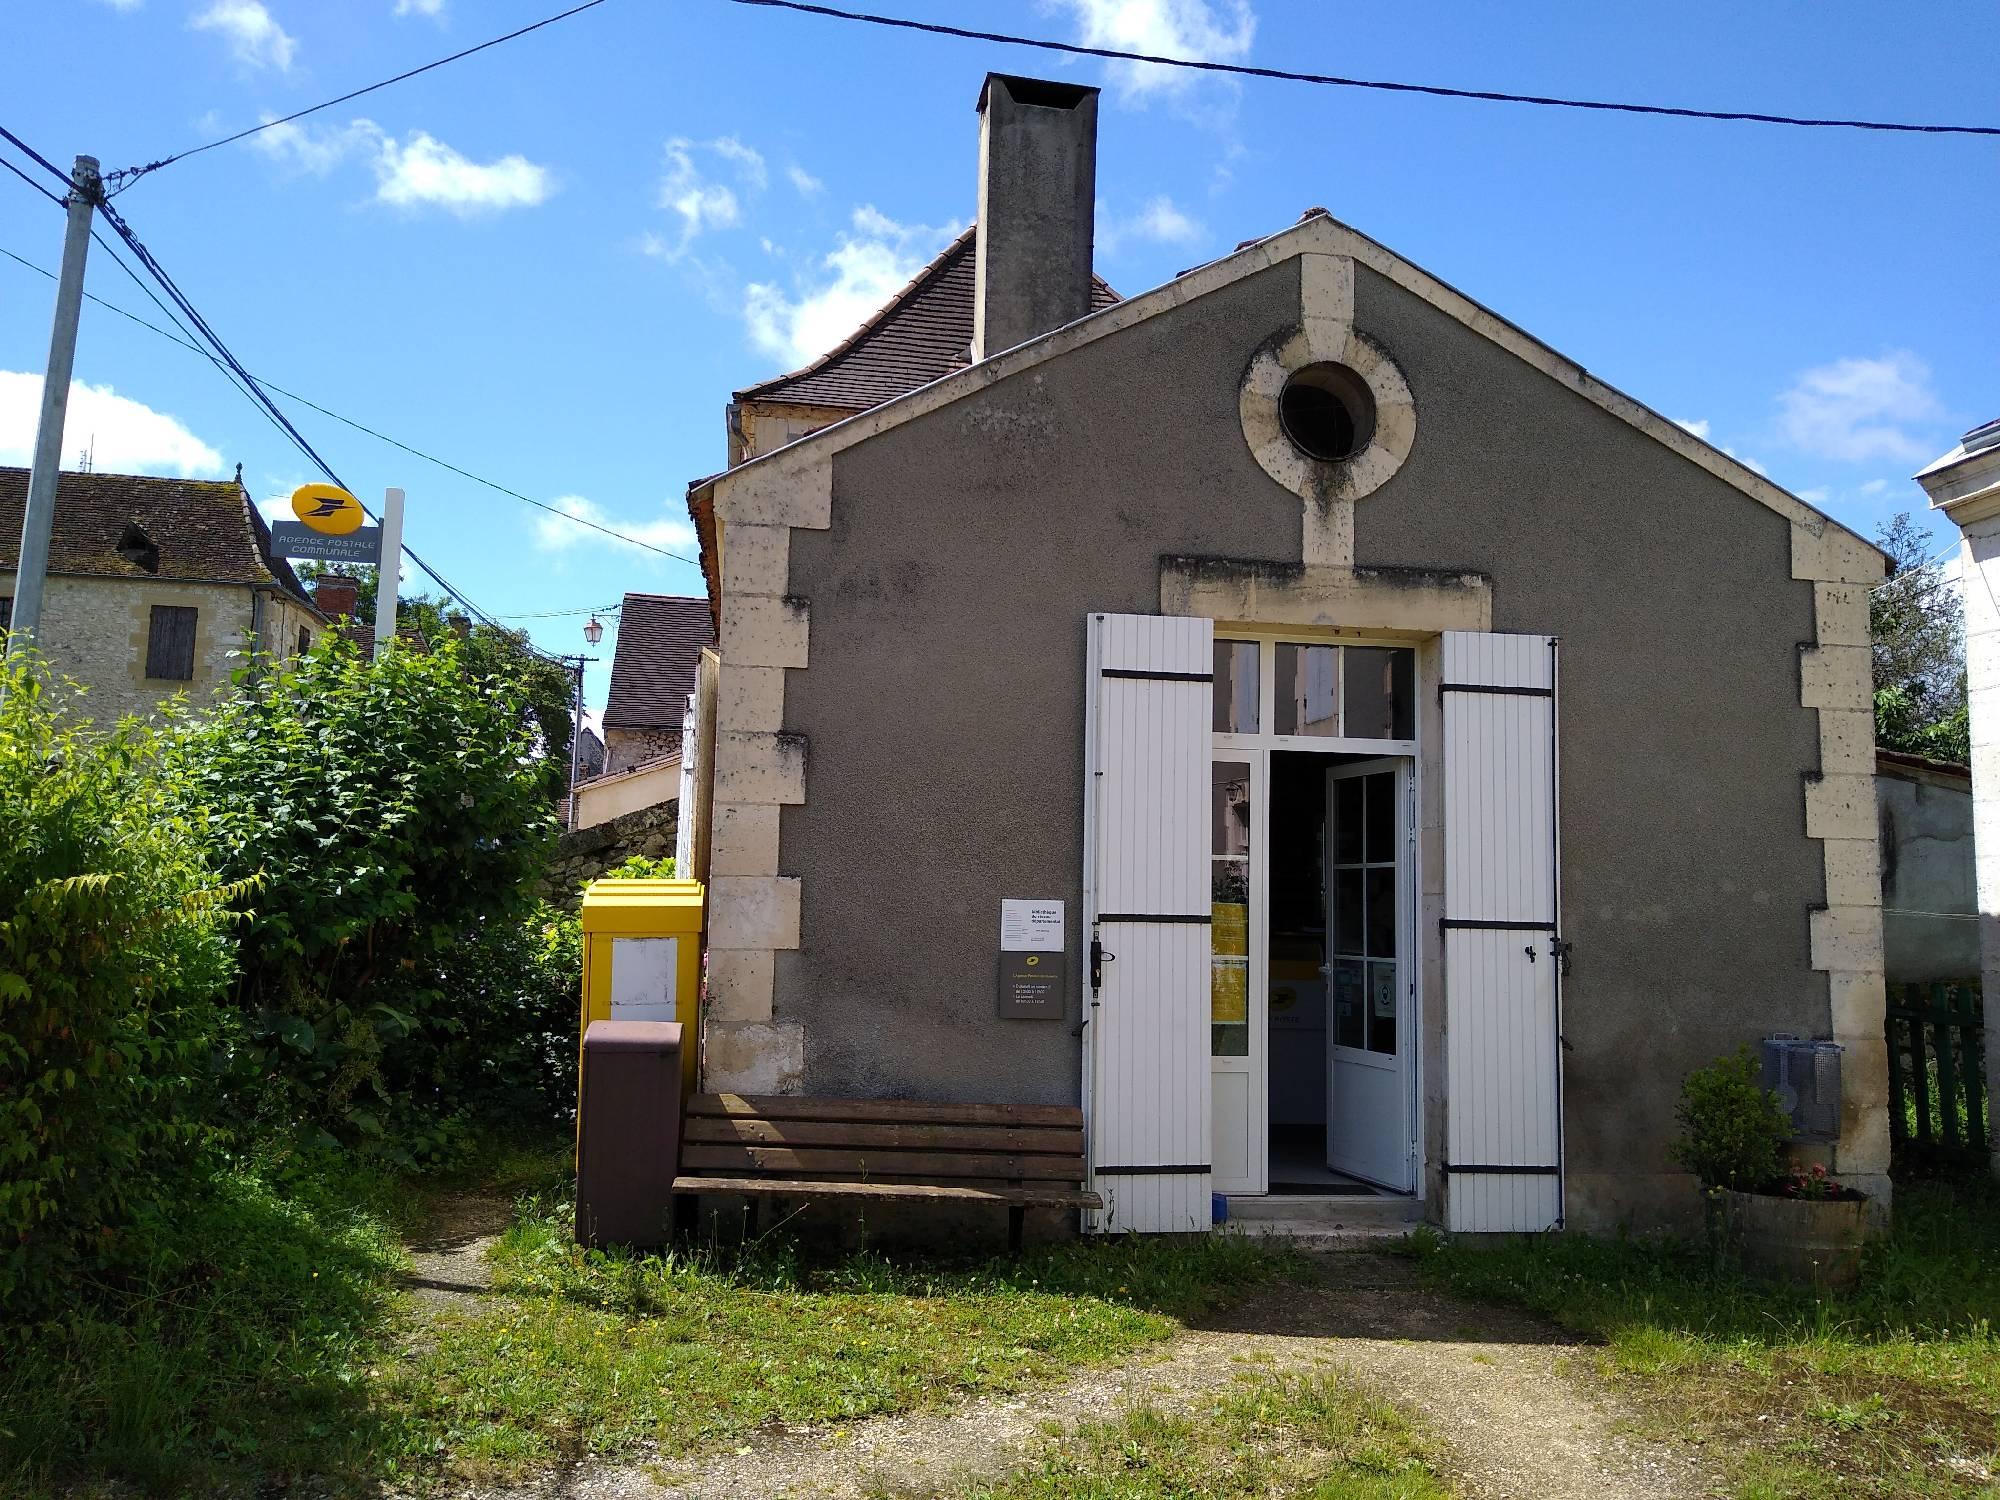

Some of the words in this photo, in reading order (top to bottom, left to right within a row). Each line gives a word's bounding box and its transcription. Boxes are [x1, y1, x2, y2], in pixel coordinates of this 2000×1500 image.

[279, 535, 325, 545] AGENCE
[327, 539, 375, 549] POSTALE
[291, 545, 361, 557] COMMUNALE
